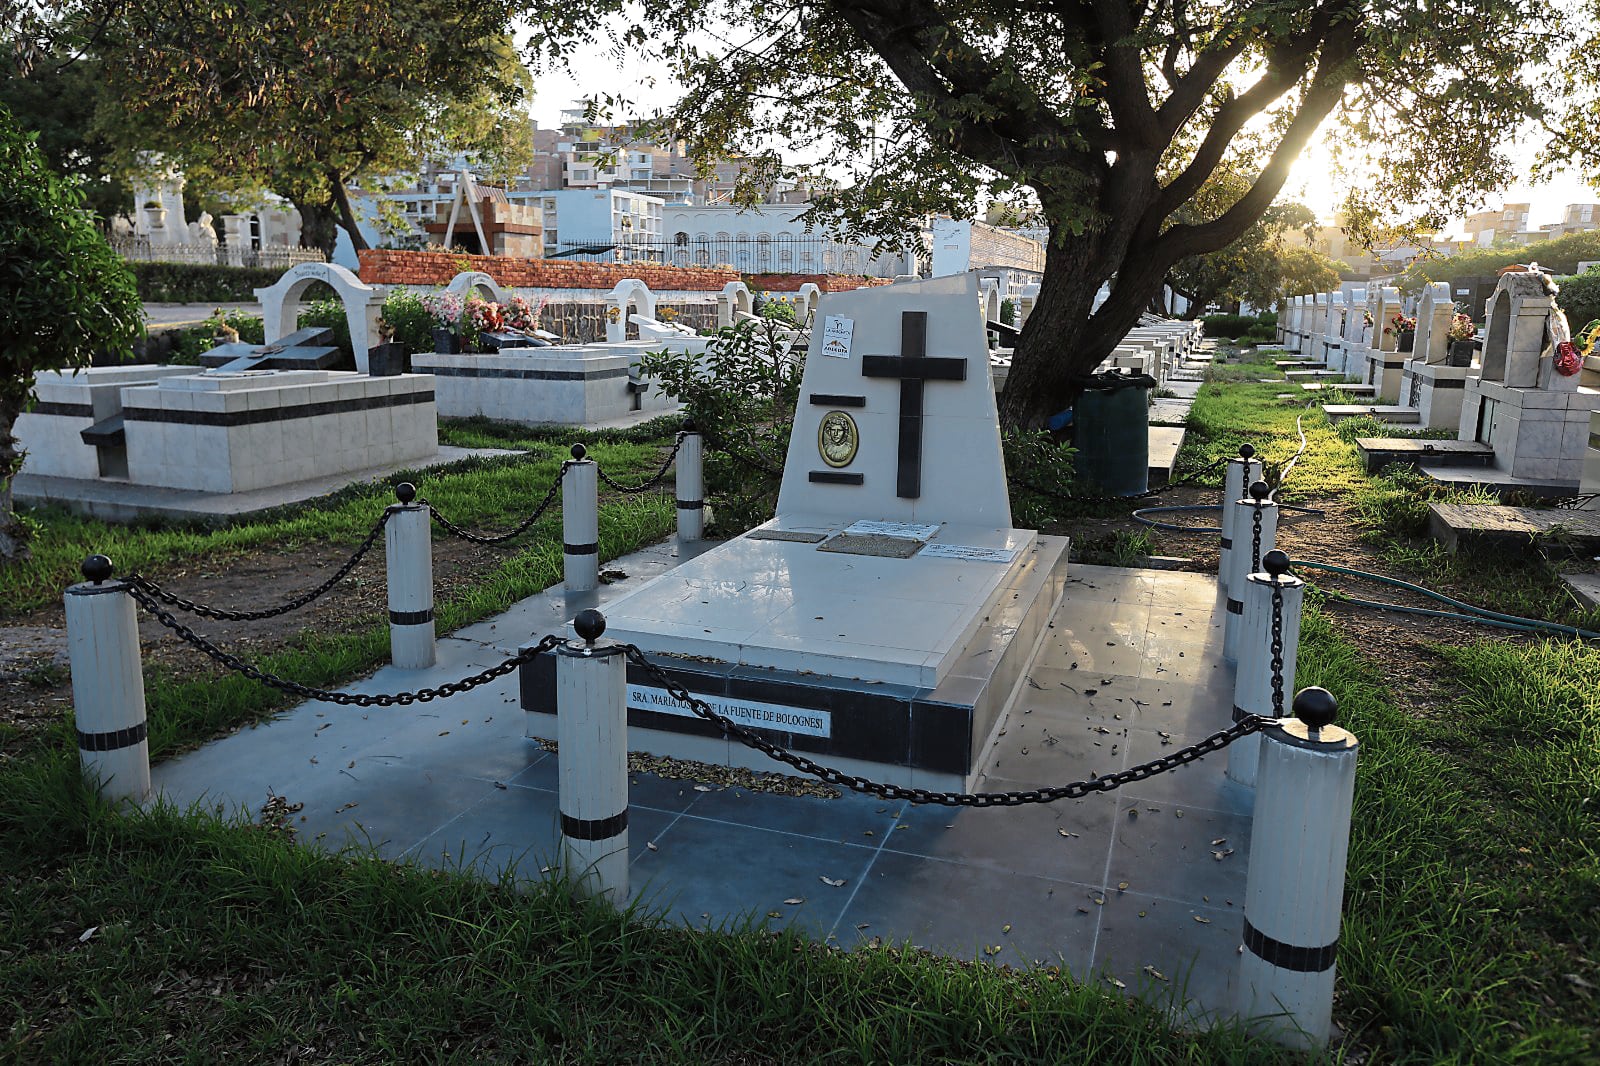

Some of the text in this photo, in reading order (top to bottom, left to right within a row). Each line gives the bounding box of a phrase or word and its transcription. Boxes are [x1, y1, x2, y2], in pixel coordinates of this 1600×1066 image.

[632, 691, 649, 704] SRA.
[650, 694, 677, 708] MARIA
[719, 704, 729, 715] LA
[730, 706, 761, 720] FUENTE
[763, 711, 775, 722] DE
[776, 713, 823, 730] BOLOGNESI
